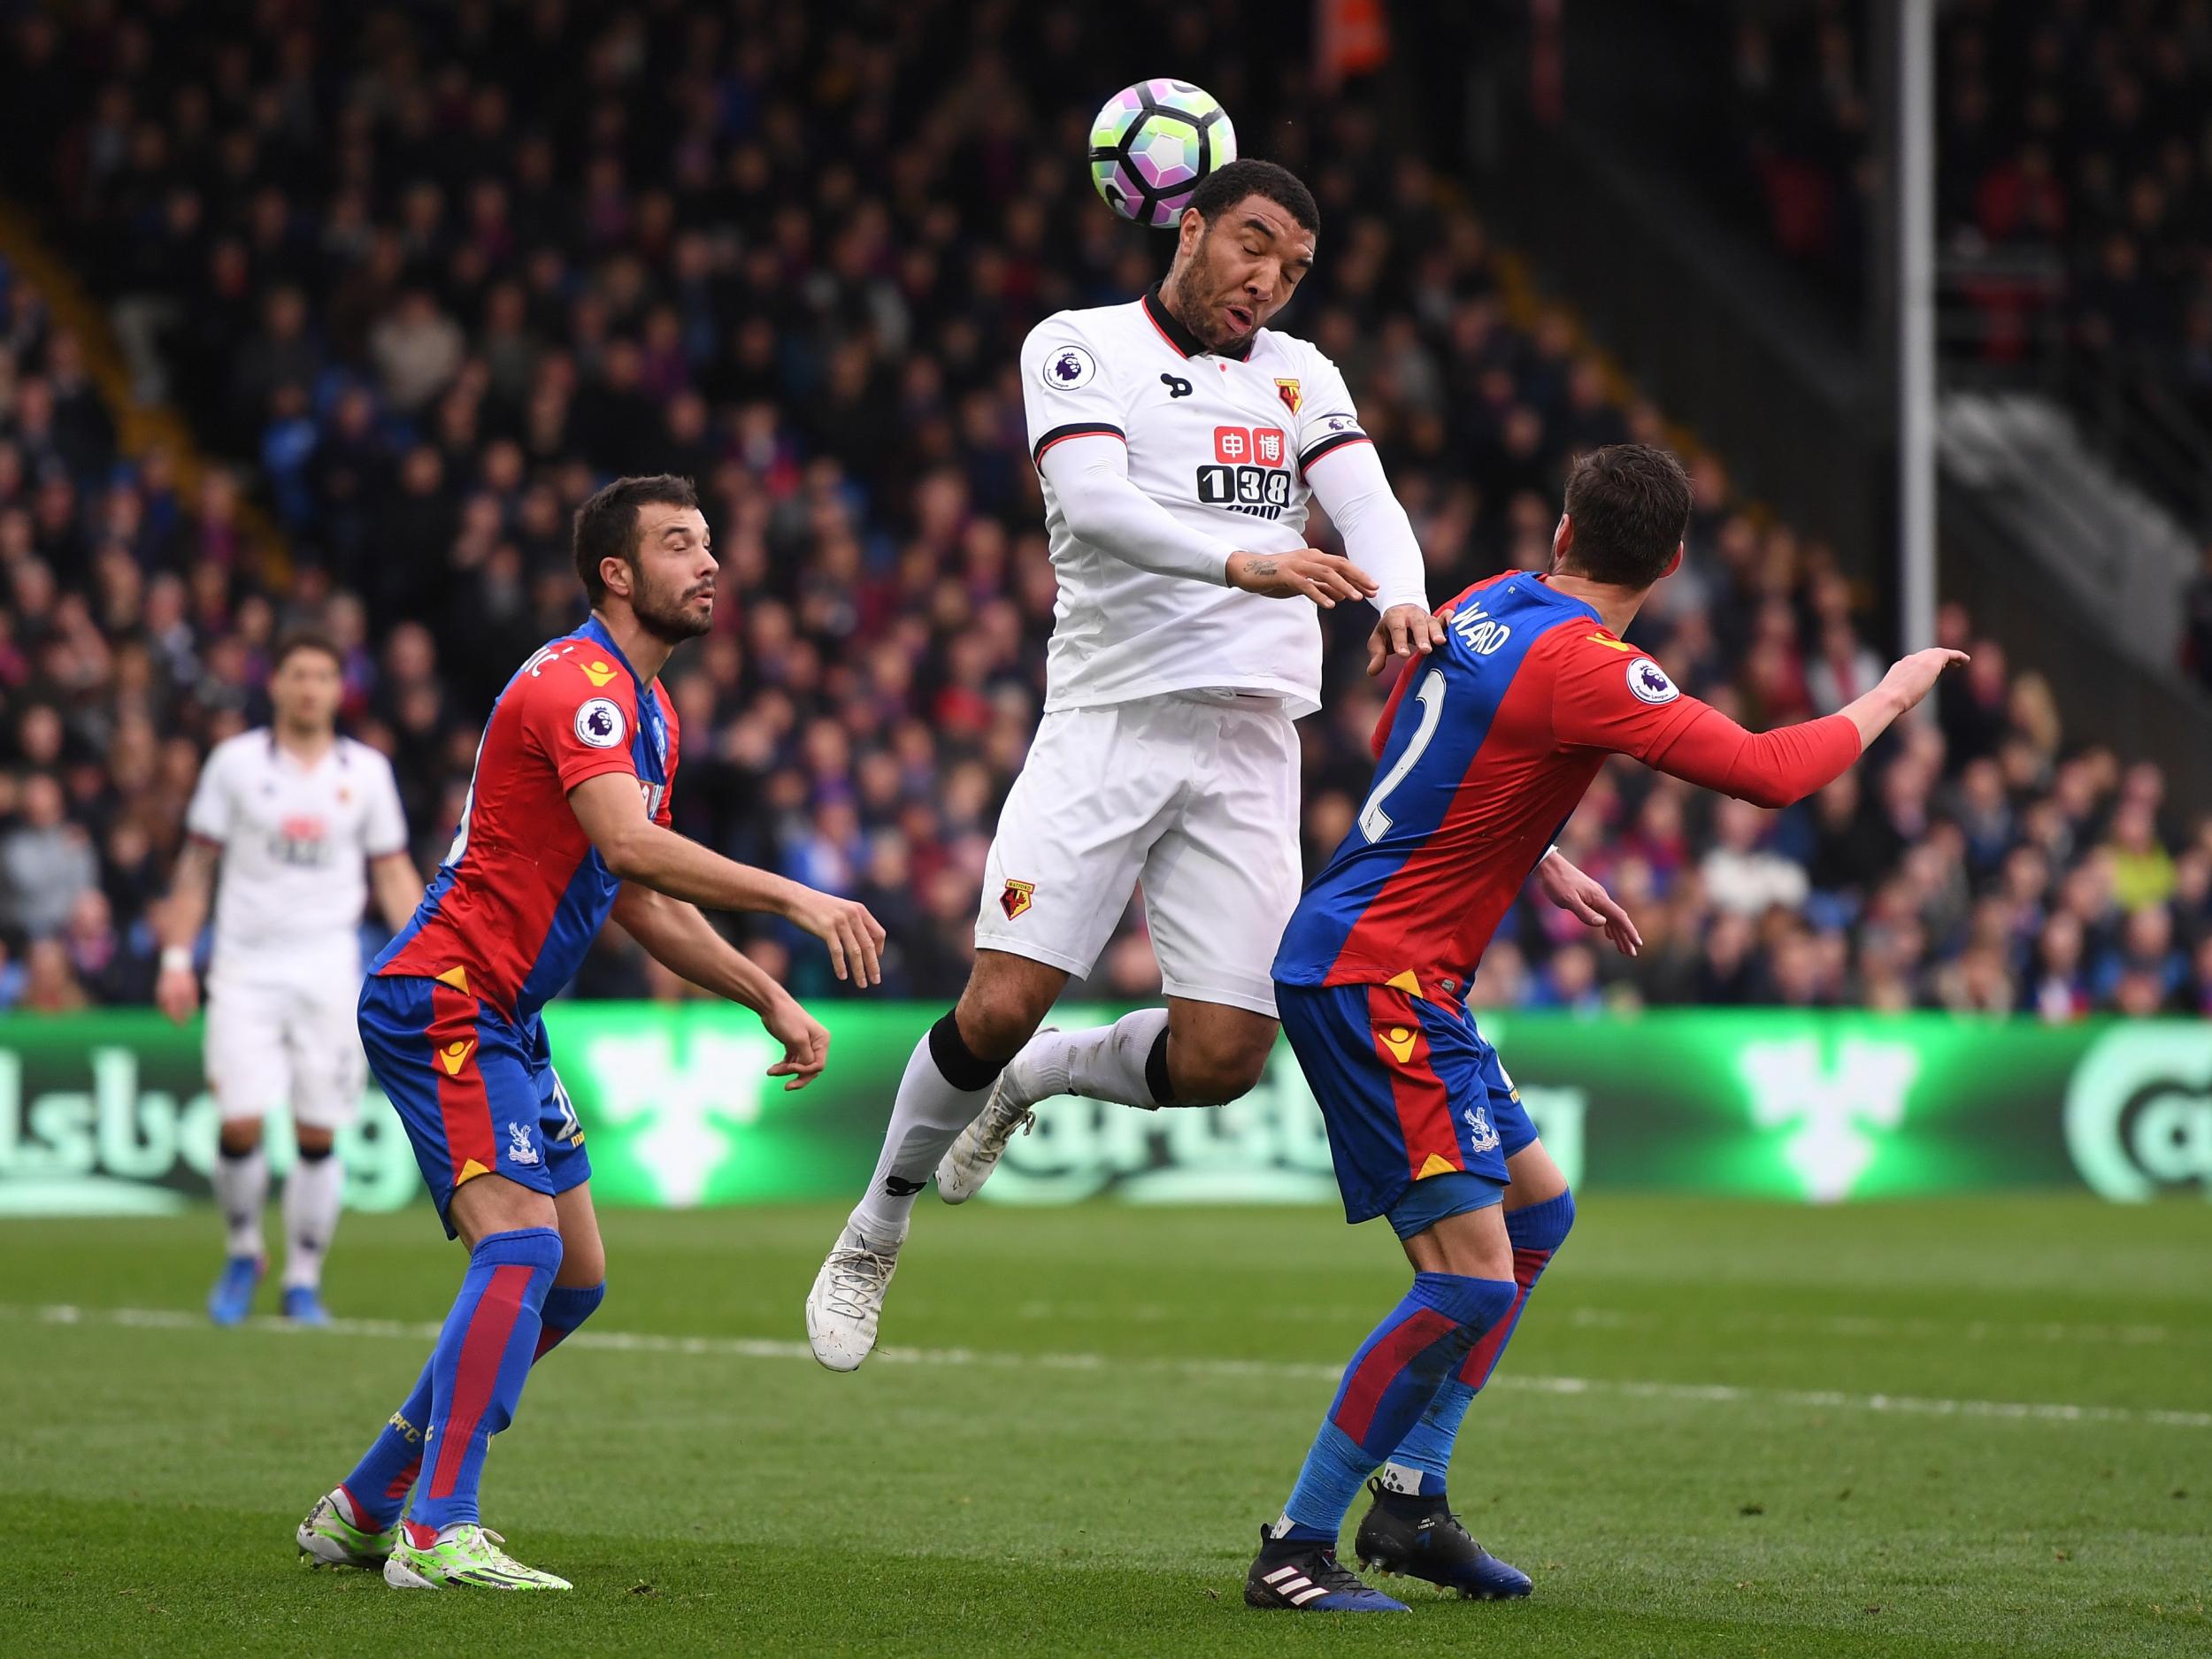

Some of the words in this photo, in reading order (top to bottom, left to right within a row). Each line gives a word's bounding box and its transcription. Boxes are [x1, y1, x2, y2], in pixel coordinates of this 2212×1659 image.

[1221, 432, 1282, 462] 申博
[1201, 468, 1289, 505] 138
[1450, 602, 1511, 655] WARD
[1358, 668, 1447, 844] 2
